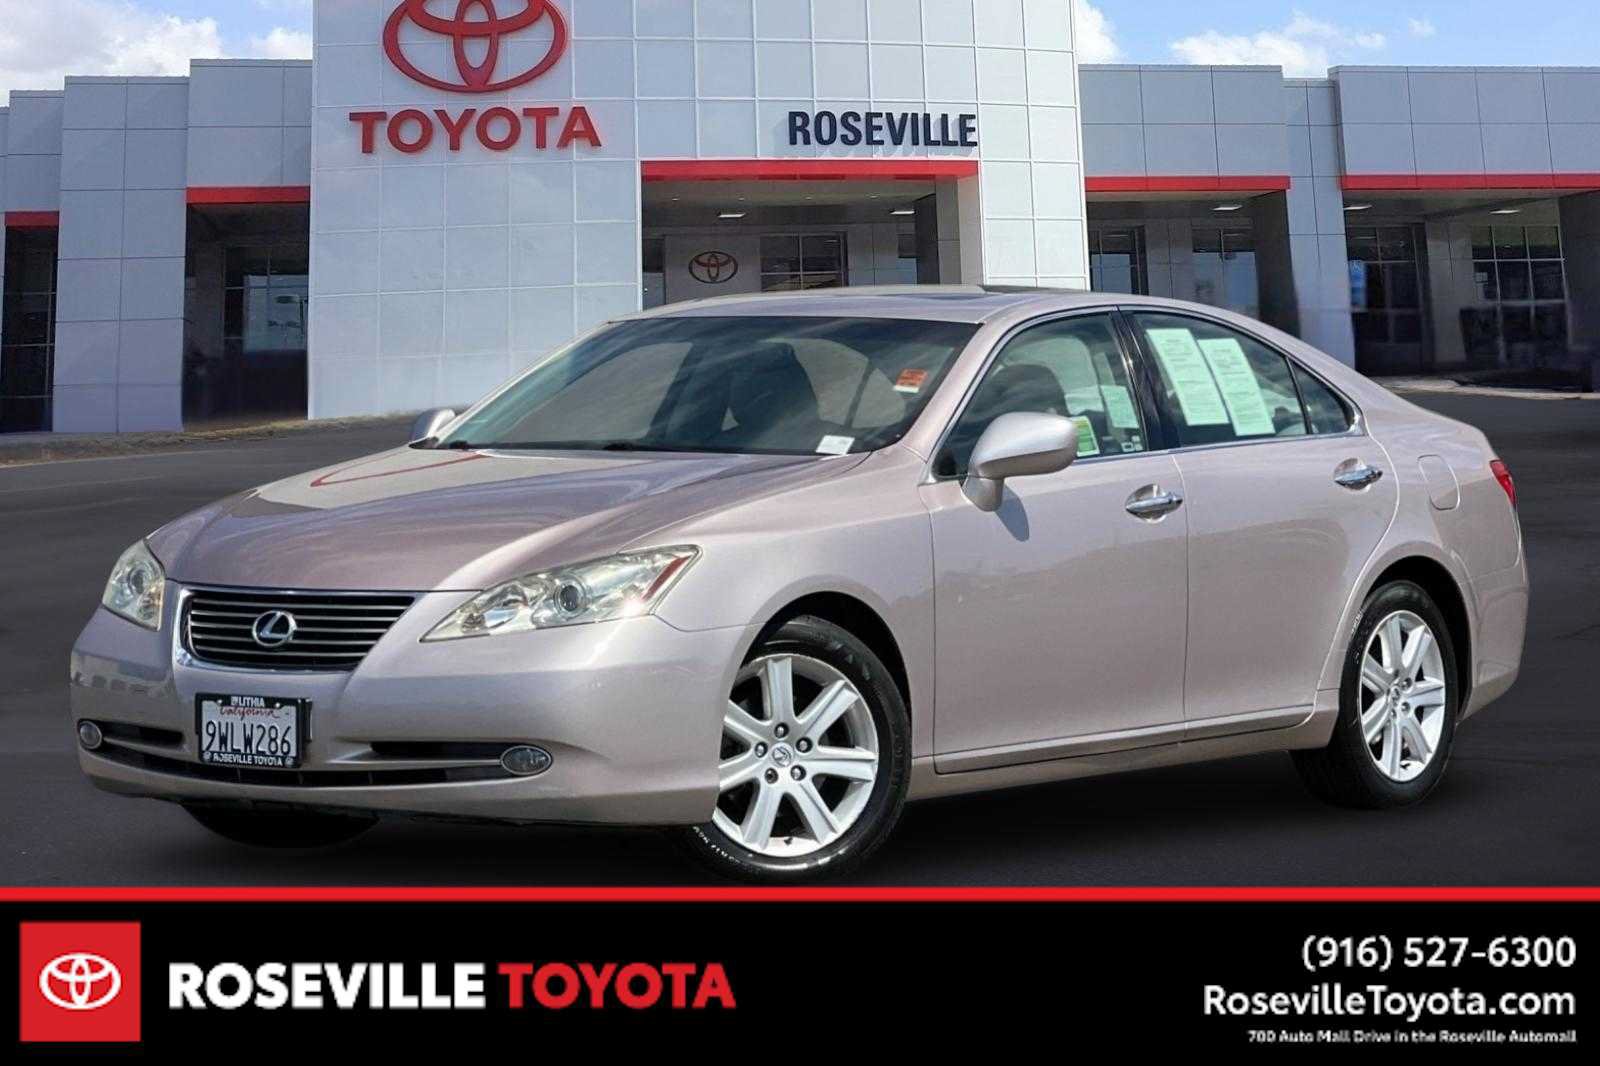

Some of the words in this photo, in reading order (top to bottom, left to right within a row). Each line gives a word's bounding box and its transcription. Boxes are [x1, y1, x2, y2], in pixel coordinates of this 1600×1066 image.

[349, 105, 603, 154] TOYOTA
[788, 111, 978, 147] ROSEVILLE
[220, 706, 280, 720] California
[205, 720, 292, 755] 9WLW286
[213, 753, 253, 764] ROSEVILLE
[254, 755, 283, 766] TOYOTA
